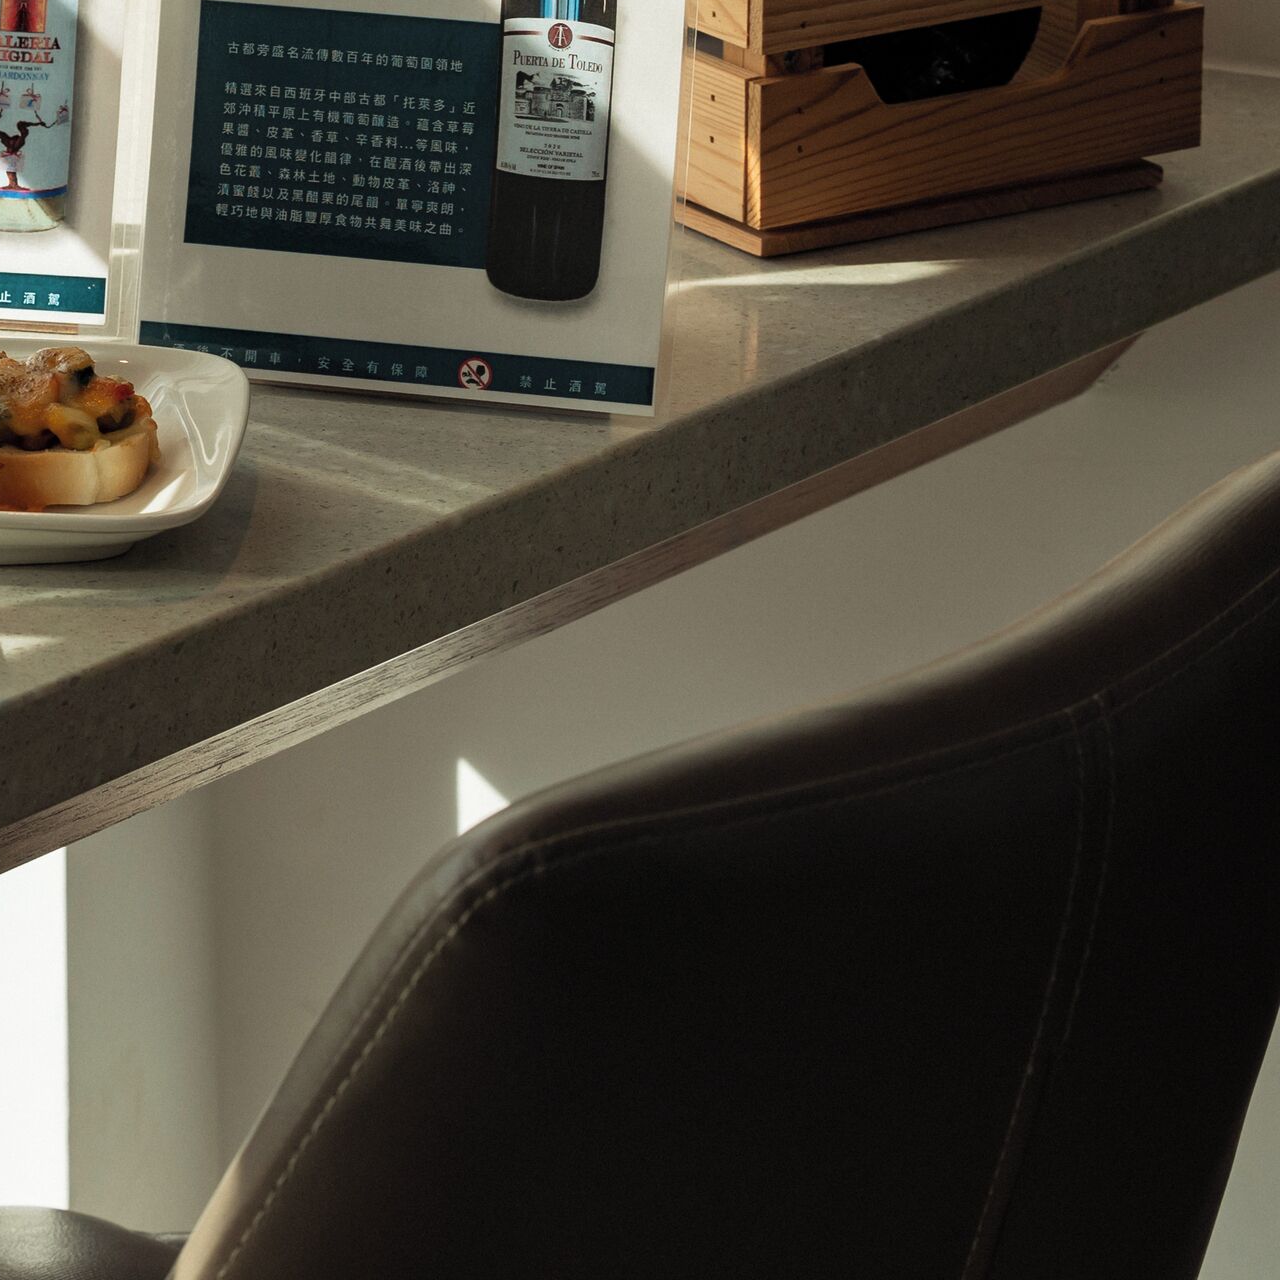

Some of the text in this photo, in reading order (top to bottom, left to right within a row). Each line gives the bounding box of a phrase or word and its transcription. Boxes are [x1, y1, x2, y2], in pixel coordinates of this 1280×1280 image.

[513, 50, 602, 73] PUERTA DE TOLEDO
[520, 375, 607, 396] 禁止酒駕
